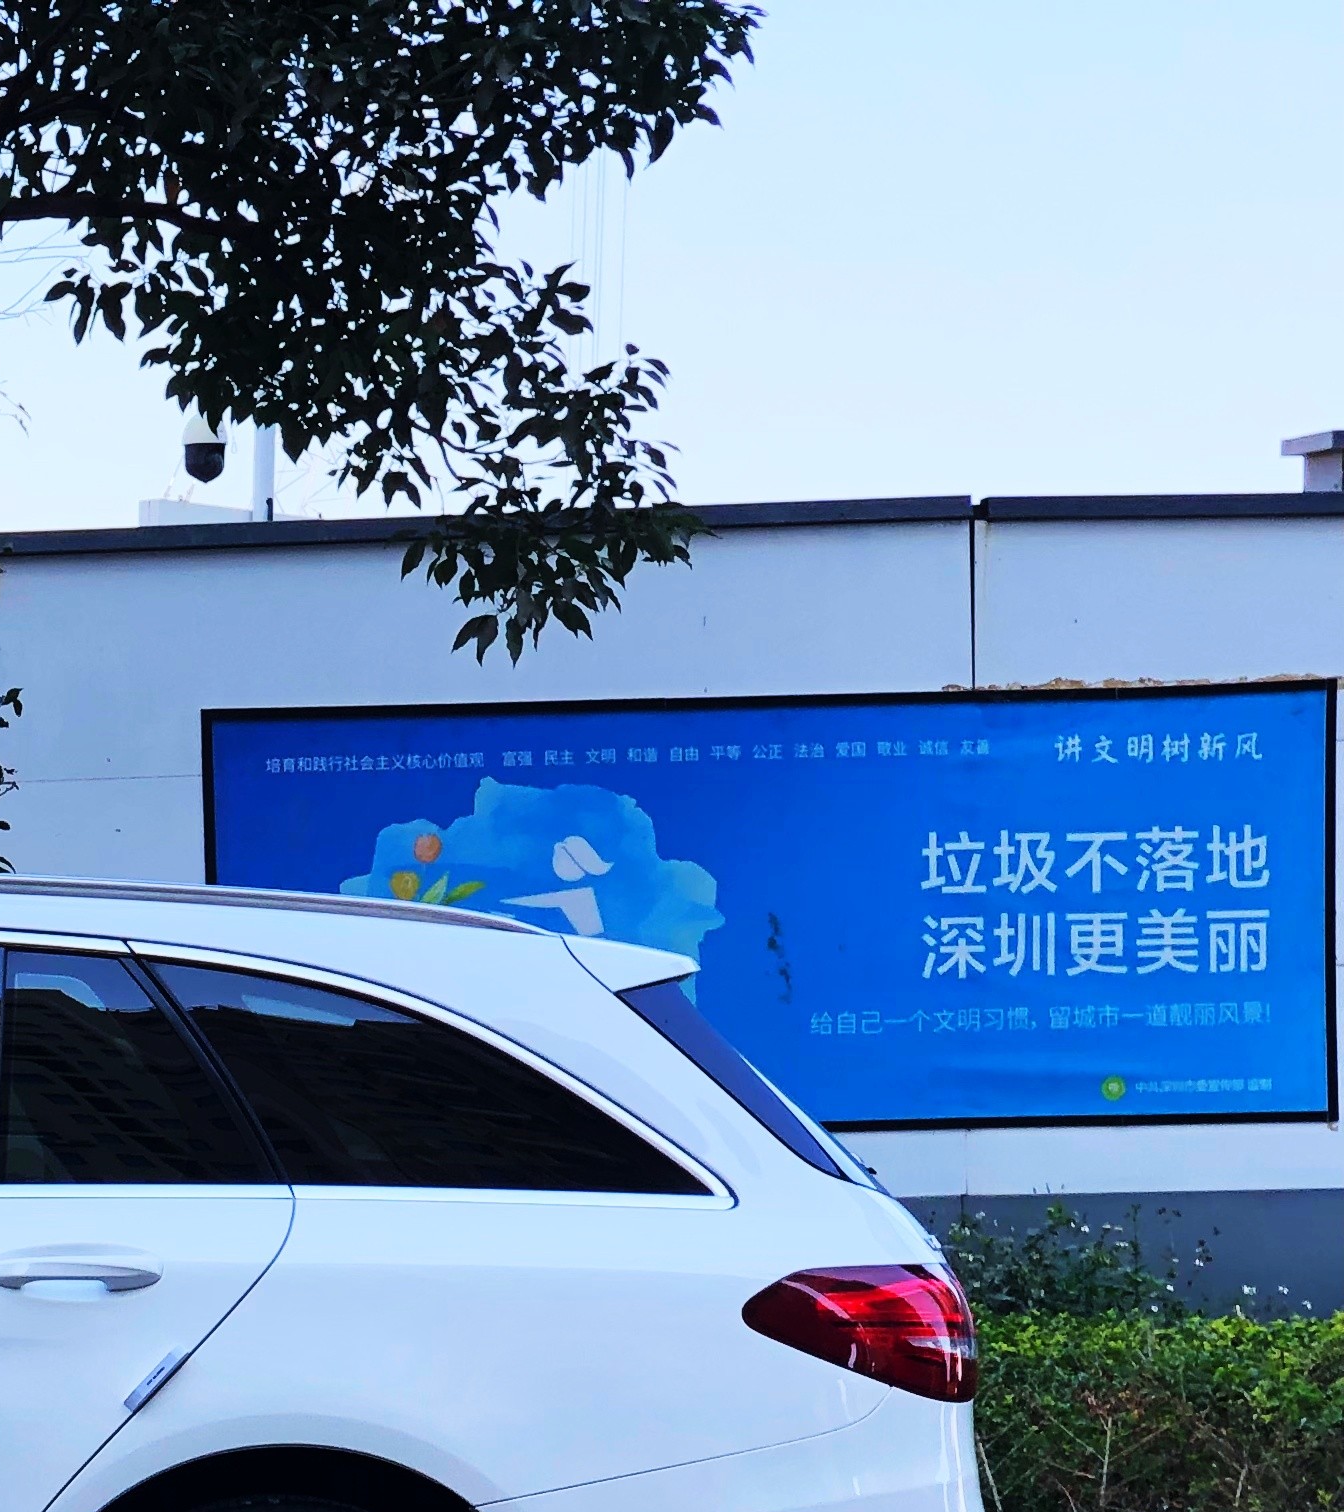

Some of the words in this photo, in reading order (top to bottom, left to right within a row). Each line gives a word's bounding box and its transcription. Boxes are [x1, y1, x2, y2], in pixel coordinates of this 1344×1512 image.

[265, 752, 484, 773] 培育和践行社会主义核心价值观
[502, 750, 532, 767] 富强
[545, 749, 574, 765] 民主
[586, 748, 616, 764] 文明
[627, 747, 657, 763] 和谐
[669, 746, 699, 762] 自由
[710, 745, 741, 761] 平等
[753, 744, 782, 759] 公正
[794, 743, 824, 758] 法治
[836, 741, 865, 757] 爱国
[877, 741, 907, 756] 敬业
[920, 740, 949, 755] 诚信
[1054, 732, 1263, 764] 讲文明树新风
[920, 824, 1270, 894] 垃圾不落地
[921, 908, 1270, 979] 深圳更美丽
